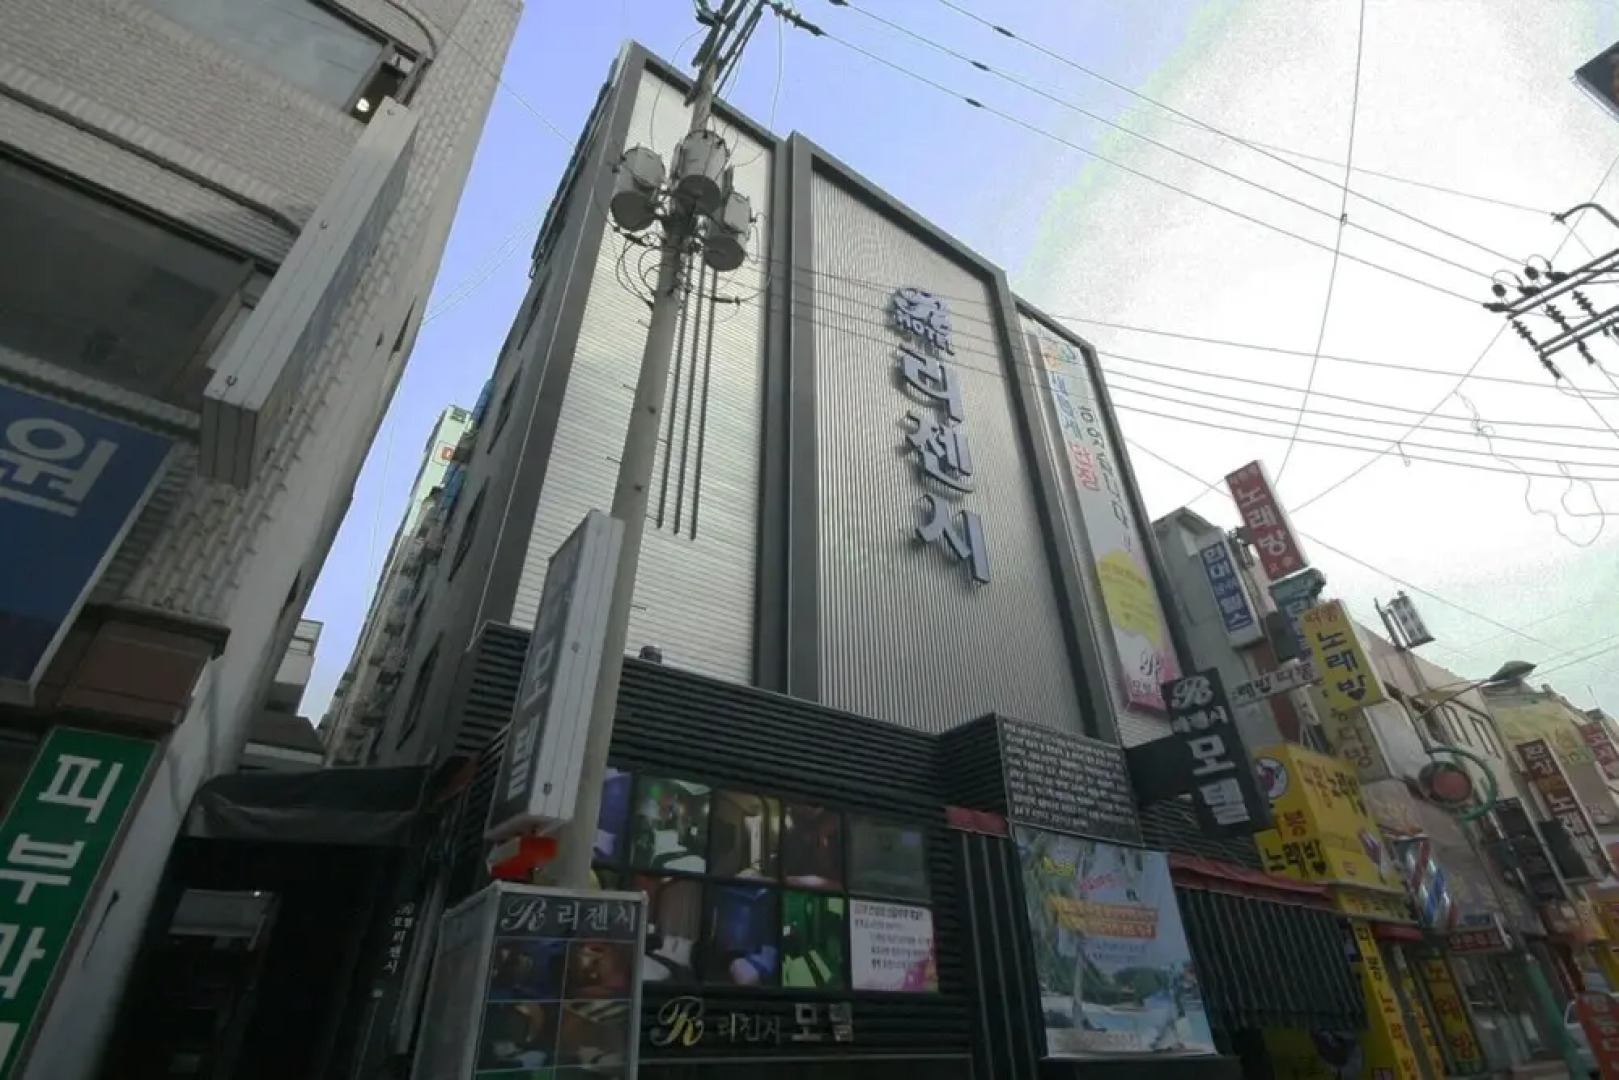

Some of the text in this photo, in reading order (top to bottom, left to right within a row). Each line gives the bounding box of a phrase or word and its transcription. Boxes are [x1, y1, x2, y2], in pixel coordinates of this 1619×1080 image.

[896, 313, 954, 357] HOTEL
[1237, 488, 1286, 556] 노래방
[1315, 632, 1367, 701] 노래방
[1187, 734, 1250, 825] 모텔
